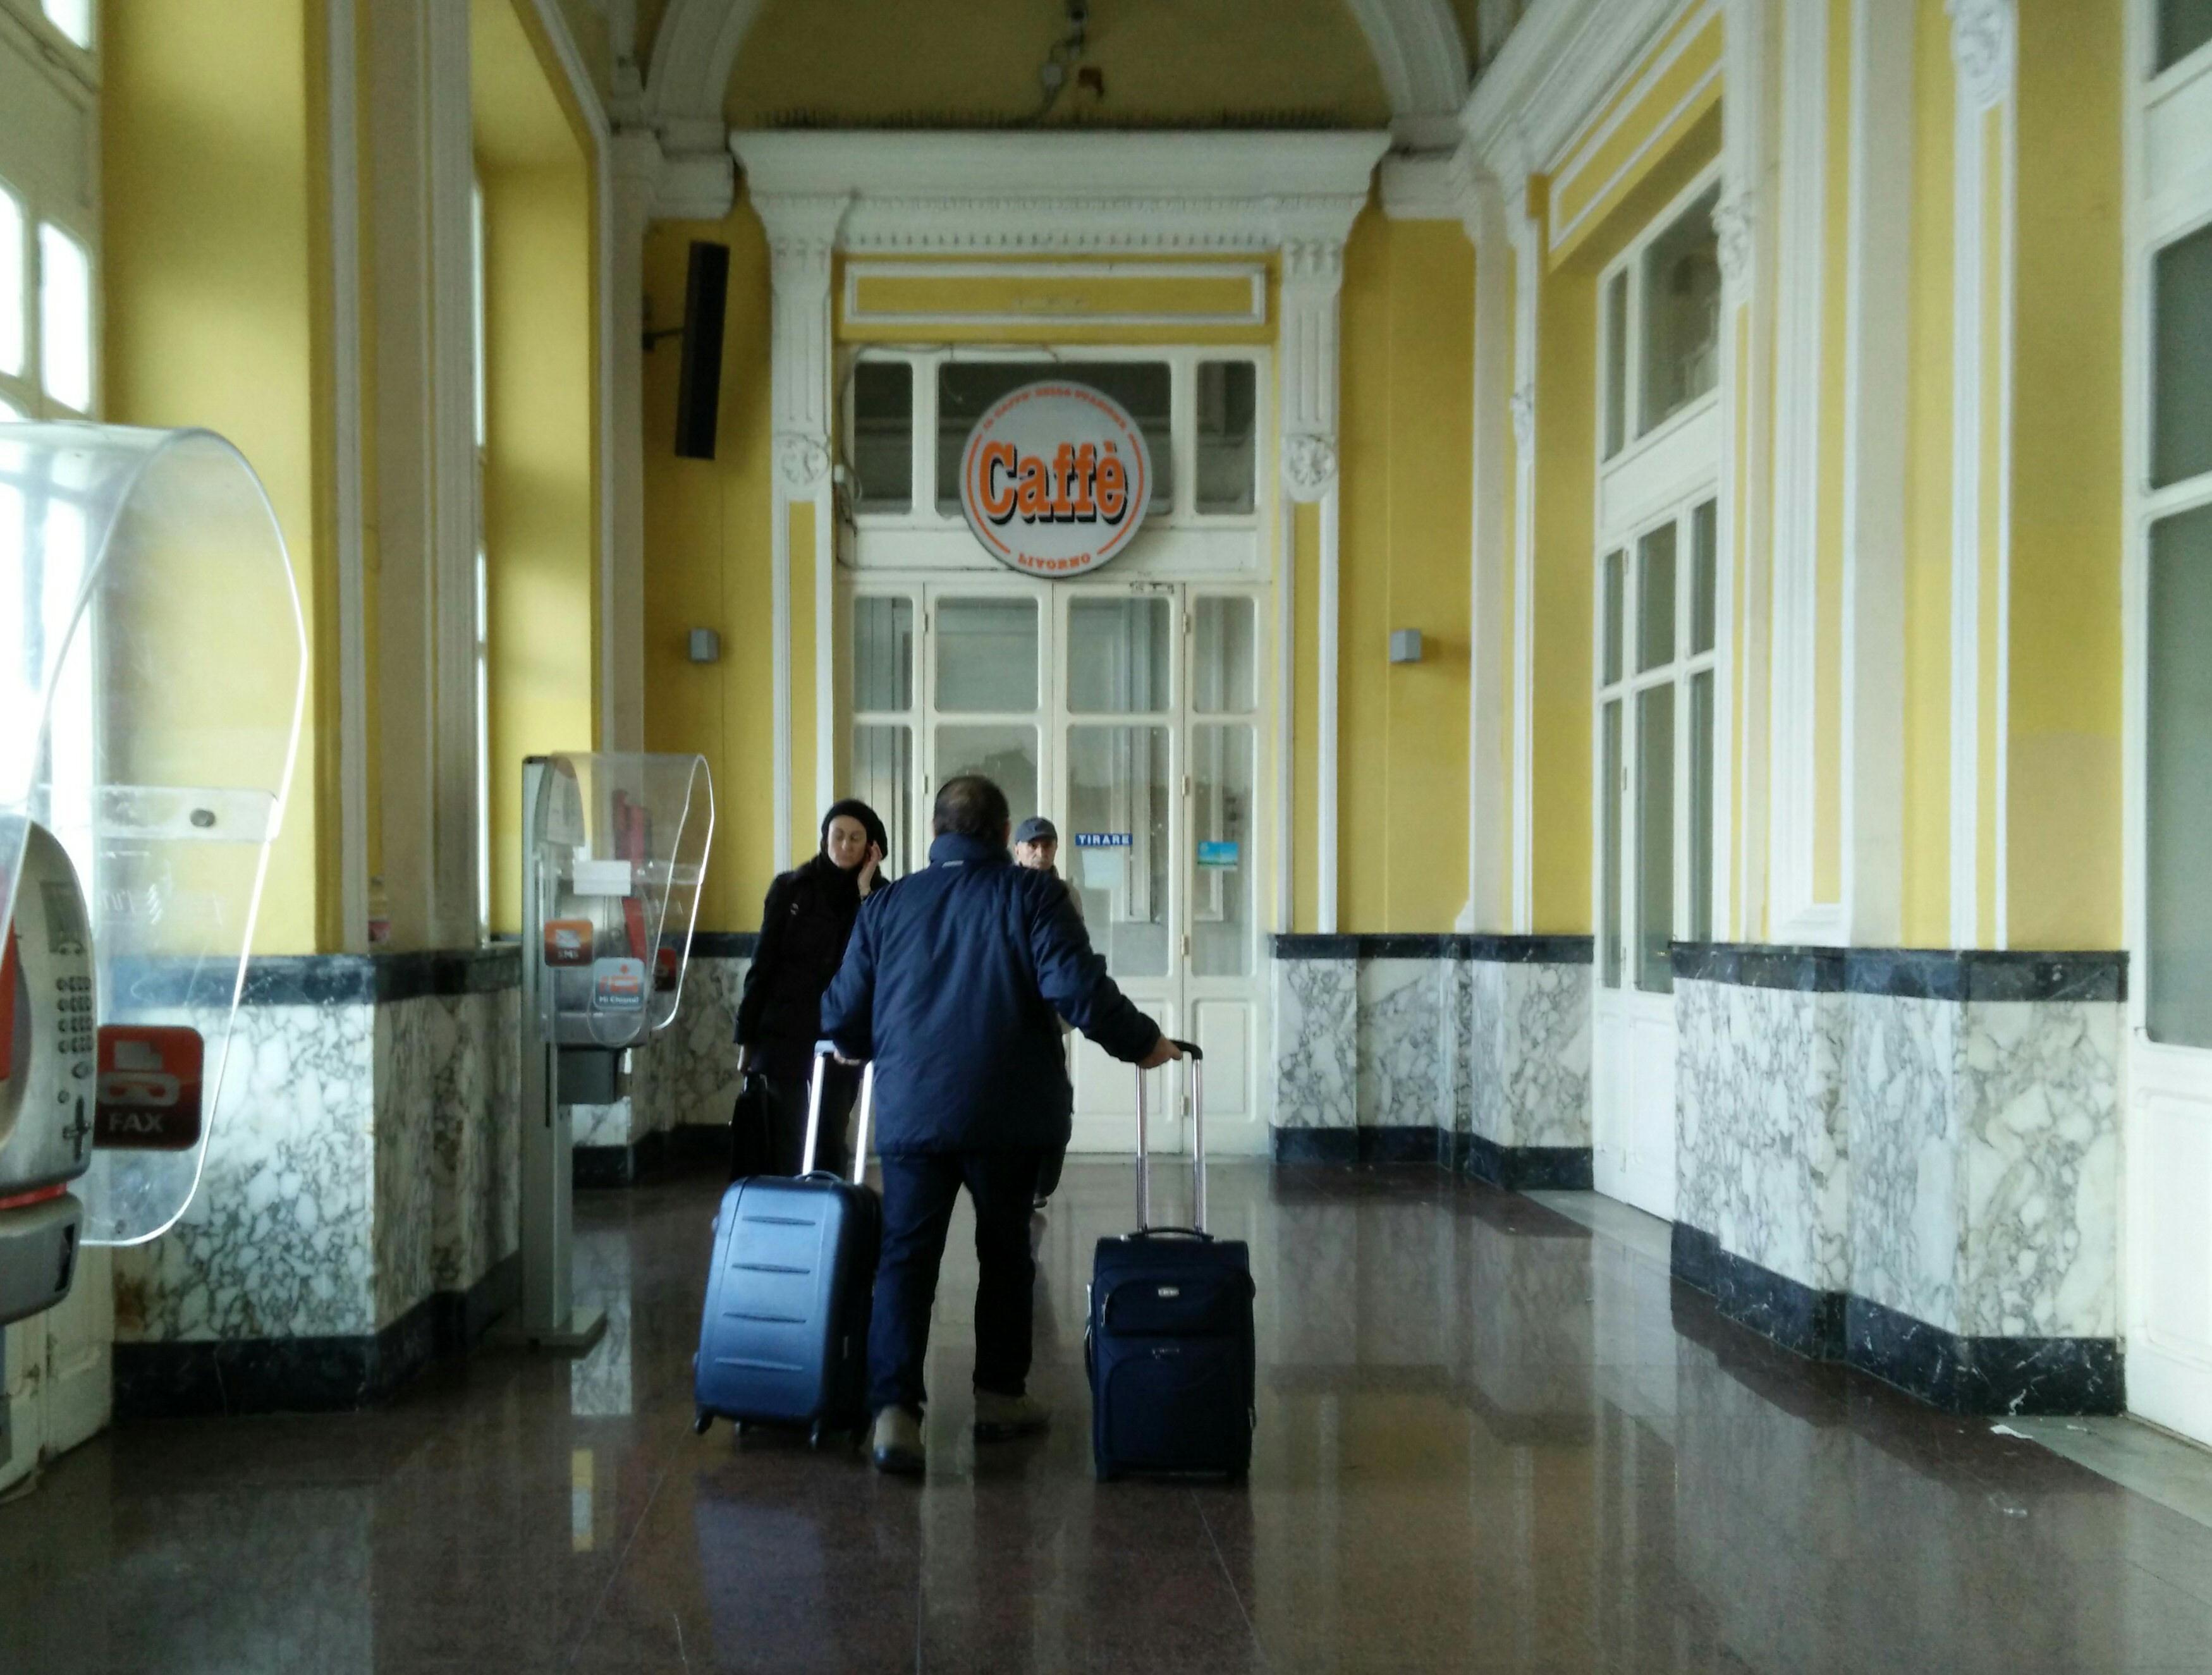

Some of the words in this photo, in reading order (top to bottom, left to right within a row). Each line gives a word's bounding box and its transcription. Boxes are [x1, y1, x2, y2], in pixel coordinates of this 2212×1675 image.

[979, 441, 1128, 525] Caffè
[1018, 552, 1091, 569] LIVORNO
[1079, 834, 1130, 845] TIRARE
[109, 1112, 164, 1133] FAX
